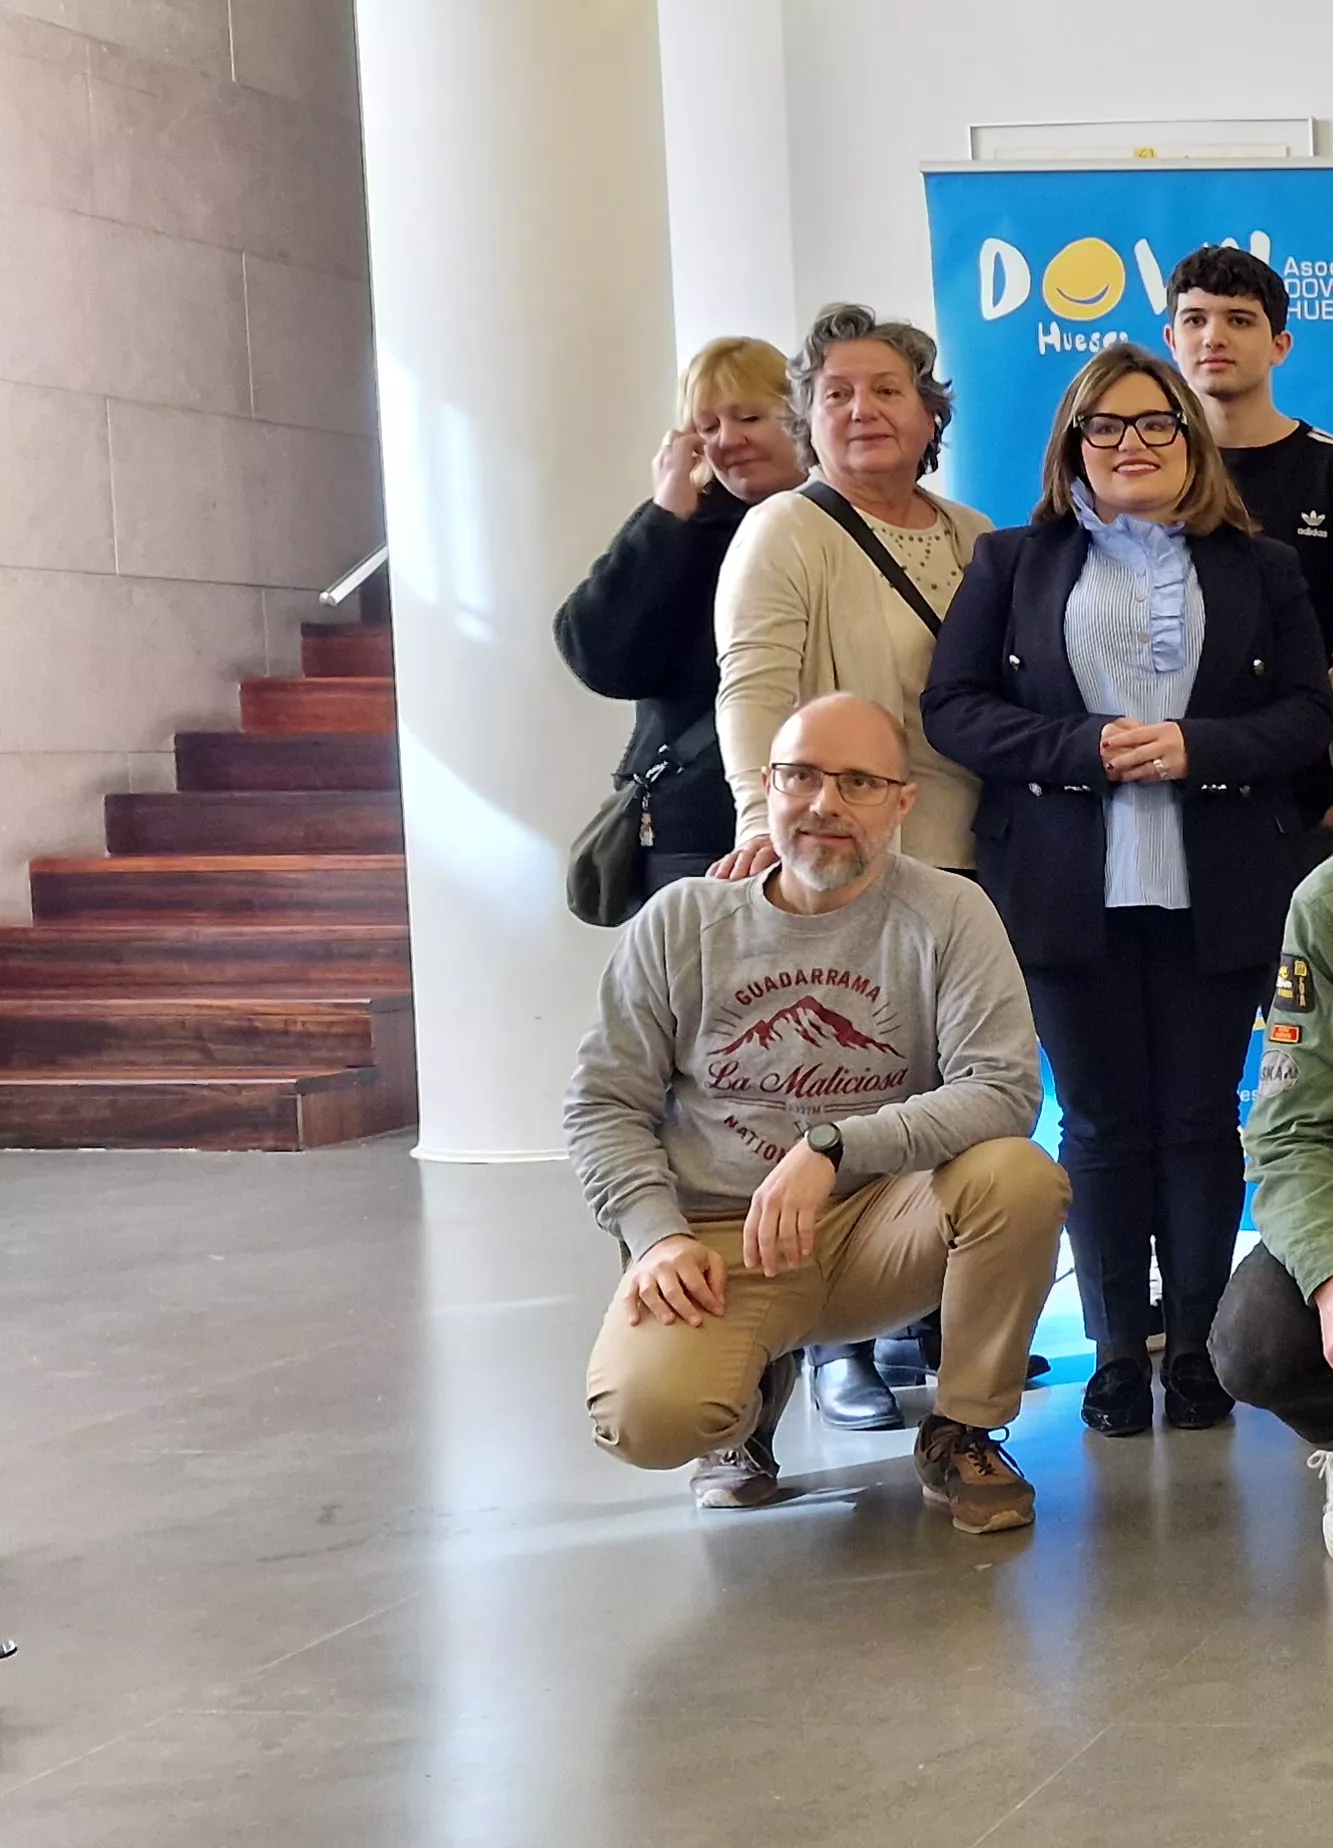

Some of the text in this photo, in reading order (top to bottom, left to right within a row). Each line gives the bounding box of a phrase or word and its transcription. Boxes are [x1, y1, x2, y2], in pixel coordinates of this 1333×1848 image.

[734, 967, 882, 1006] GUADARRAMA
[706, 1060, 909, 1099] La Maliciosa
